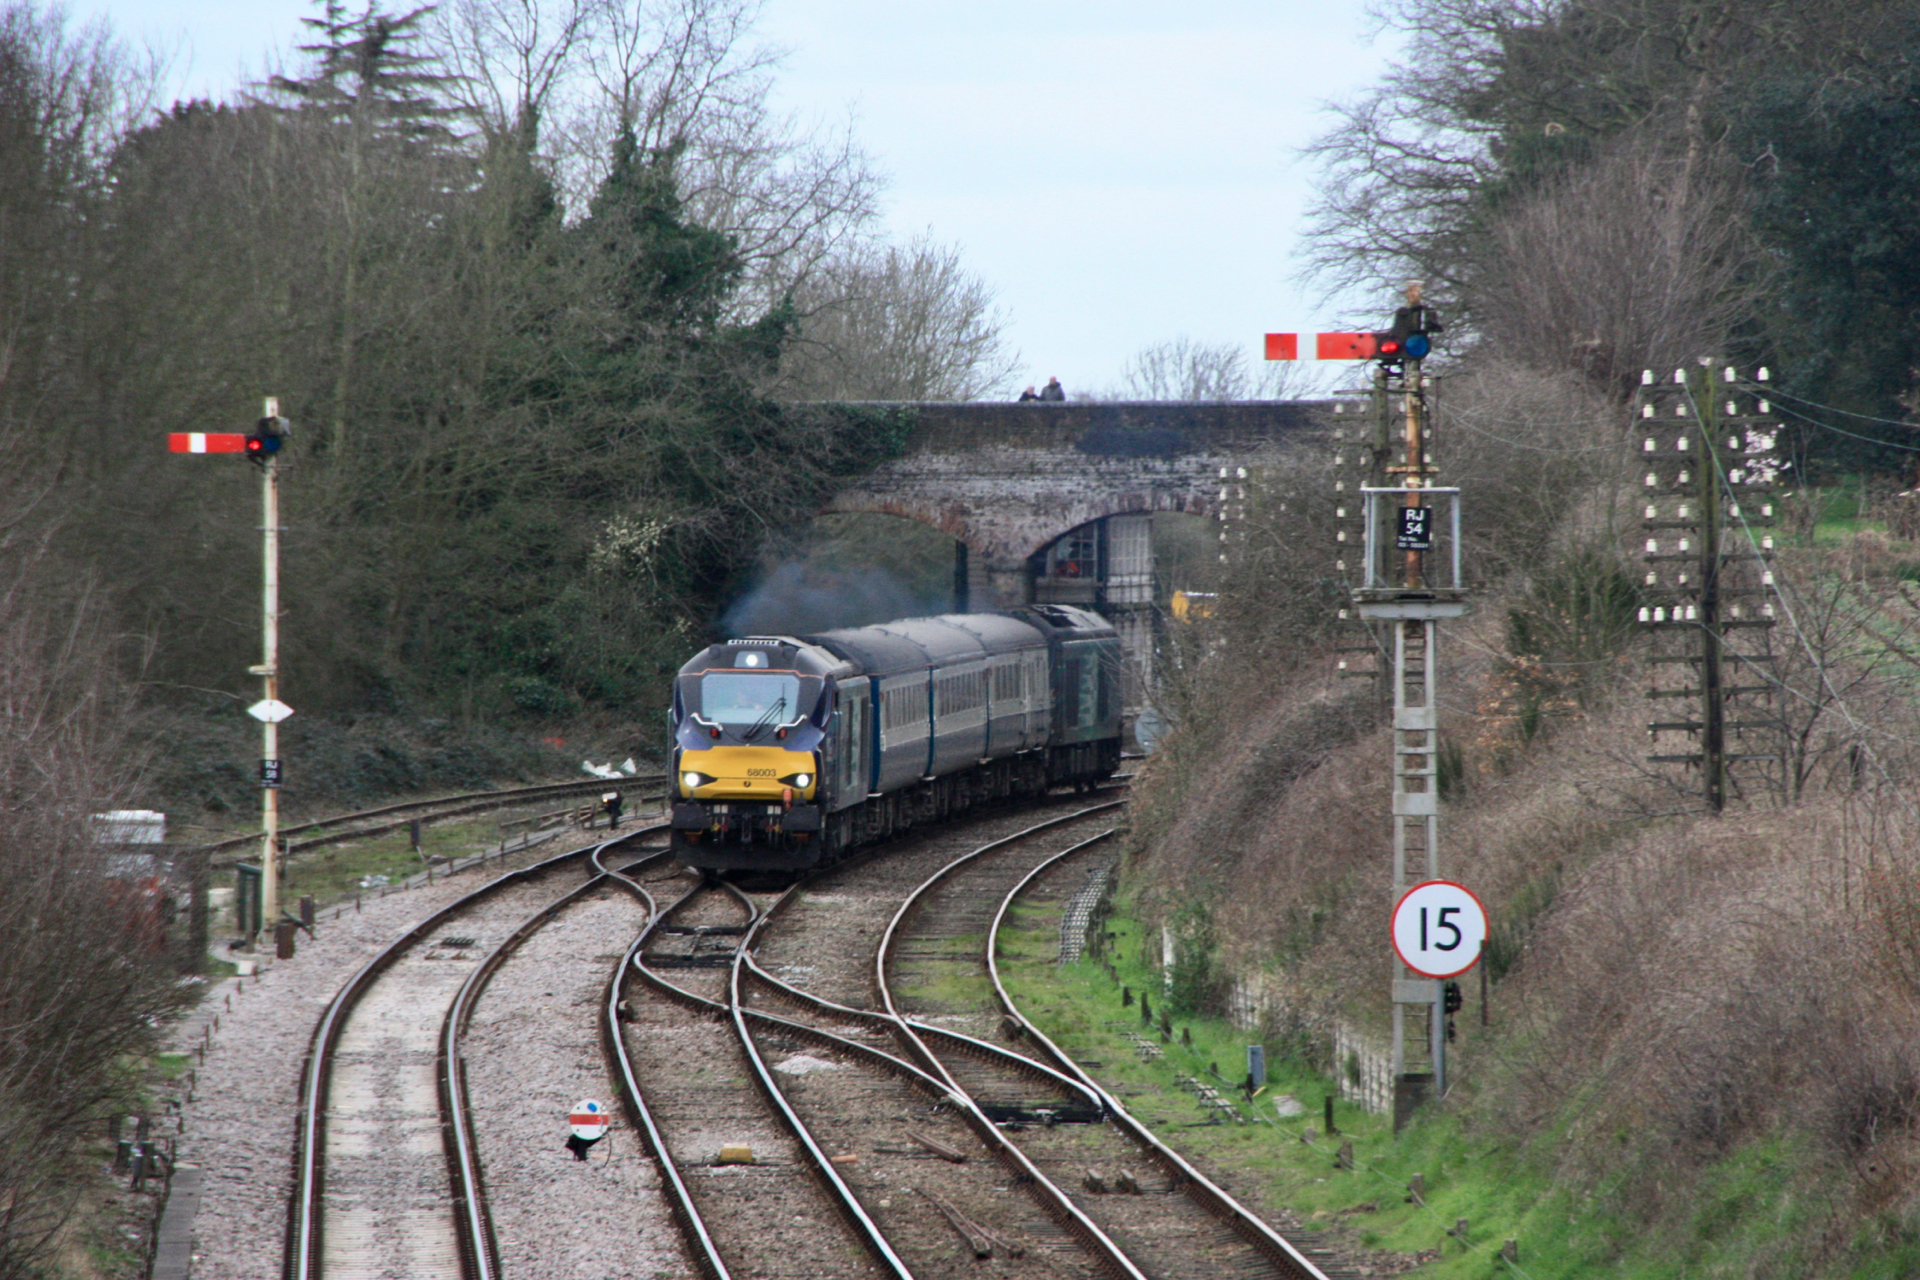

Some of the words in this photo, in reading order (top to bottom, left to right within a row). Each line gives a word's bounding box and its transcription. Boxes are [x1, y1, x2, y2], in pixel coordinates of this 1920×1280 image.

[1405, 509, 1424, 521] RJ
[1405, 522, 1423, 535] 54
[265, 760, 278, 769] RJ
[747, 768, 777, 777] 68003
[1420, 906, 1462, 952] 15
